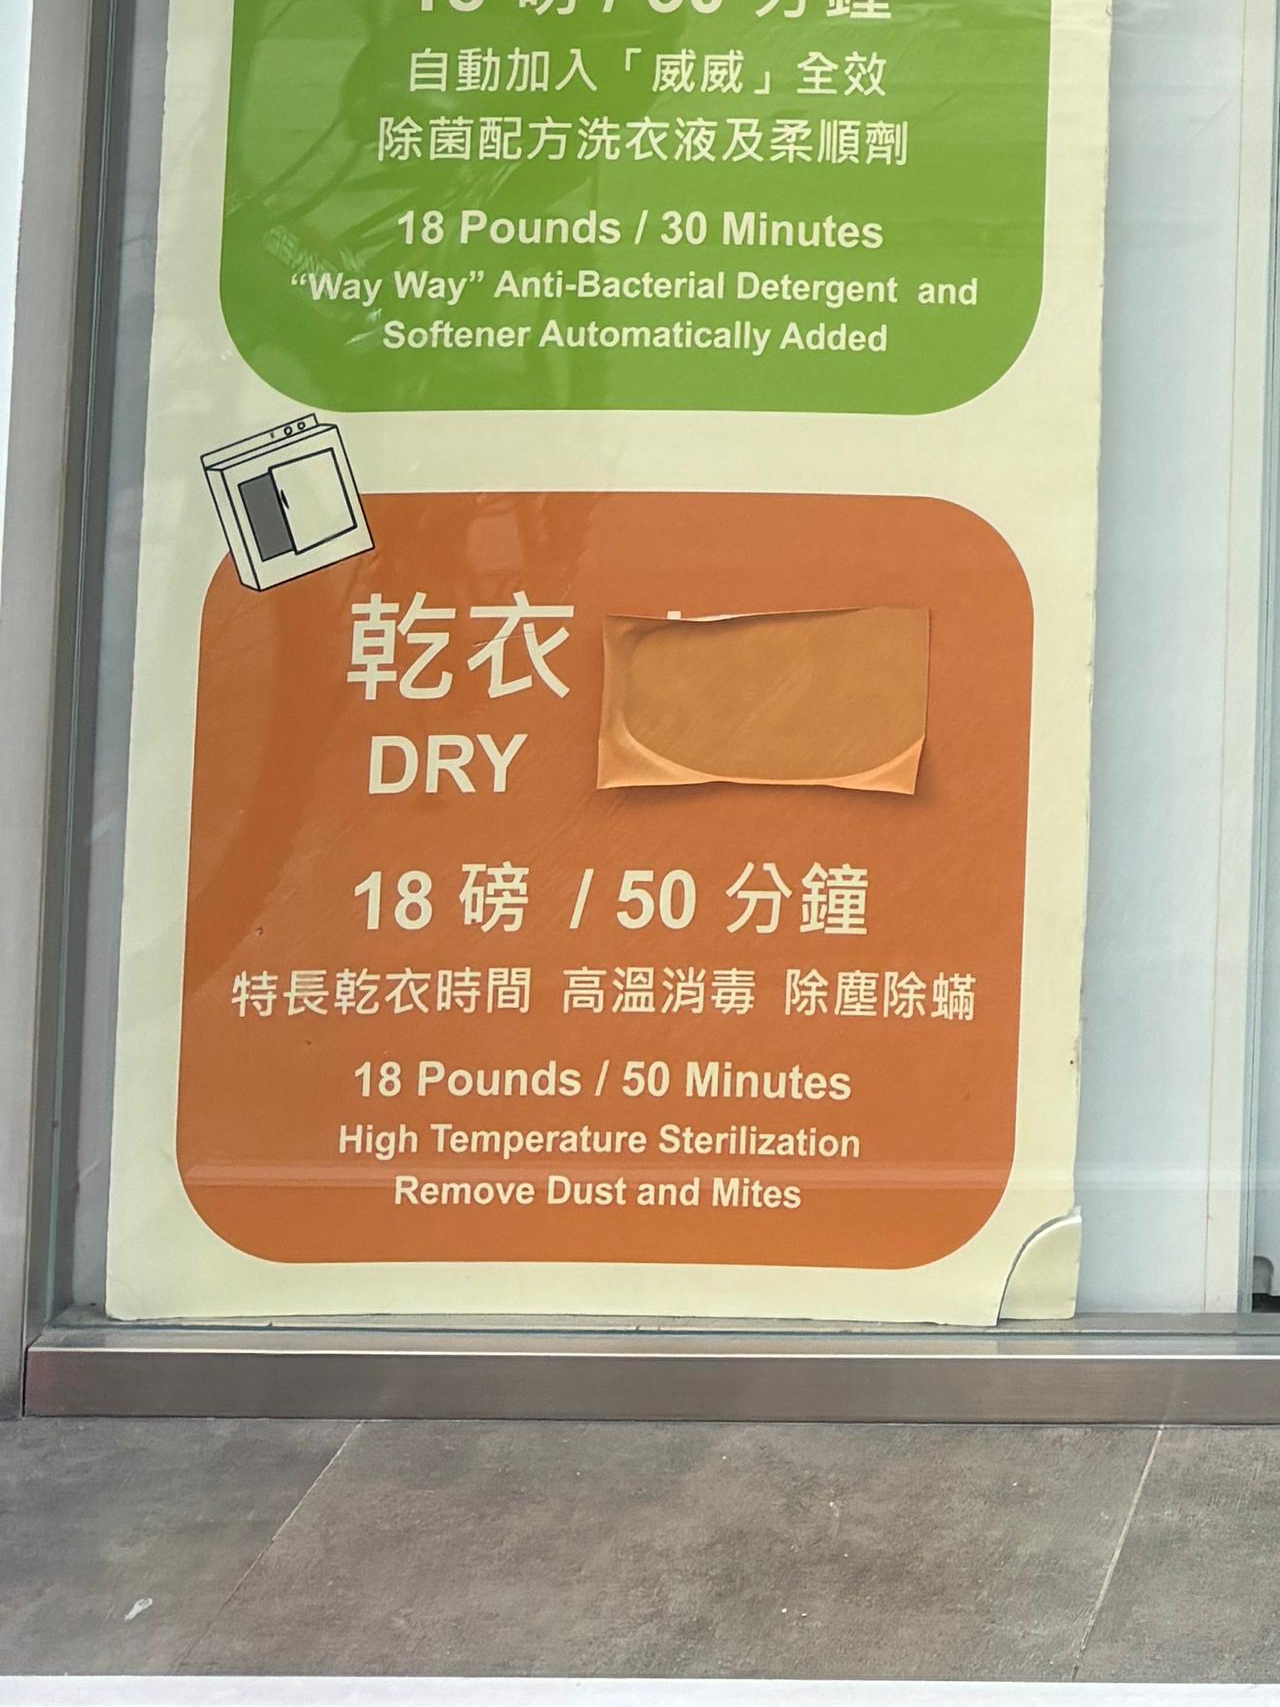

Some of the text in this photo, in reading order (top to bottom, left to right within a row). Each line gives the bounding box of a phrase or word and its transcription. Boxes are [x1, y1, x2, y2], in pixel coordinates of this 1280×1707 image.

[408, 46, 888, 98] 自動加入「威威」全效
[377, 115, 910, 168] 除菌配方洗衣液及柔順劑
[397, 211, 884, 250] 18 Pounds 30 Minutes
[493, 271, 726, 302] Anti-Bacterial
[735, 273, 899, 311] Detergent
[917, 276, 978, 306] and
[382, 320, 889, 357] Softener Automatically Added
[345, 591, 575, 703] 乾衣
[368, 734, 528, 796] DRY
[353, 861, 869, 938] 18 磅 50 分鐘
[230, 966, 977, 1024] 特長乾衣時間 高溫消毒 除塵除蟎
[353, 1061, 852, 1102] 18 Pounds 50 Minutes
[338, 1124, 861, 1162] High Temperature Sterilization
[393, 1177, 802, 1210] Remove Dust and Mites
